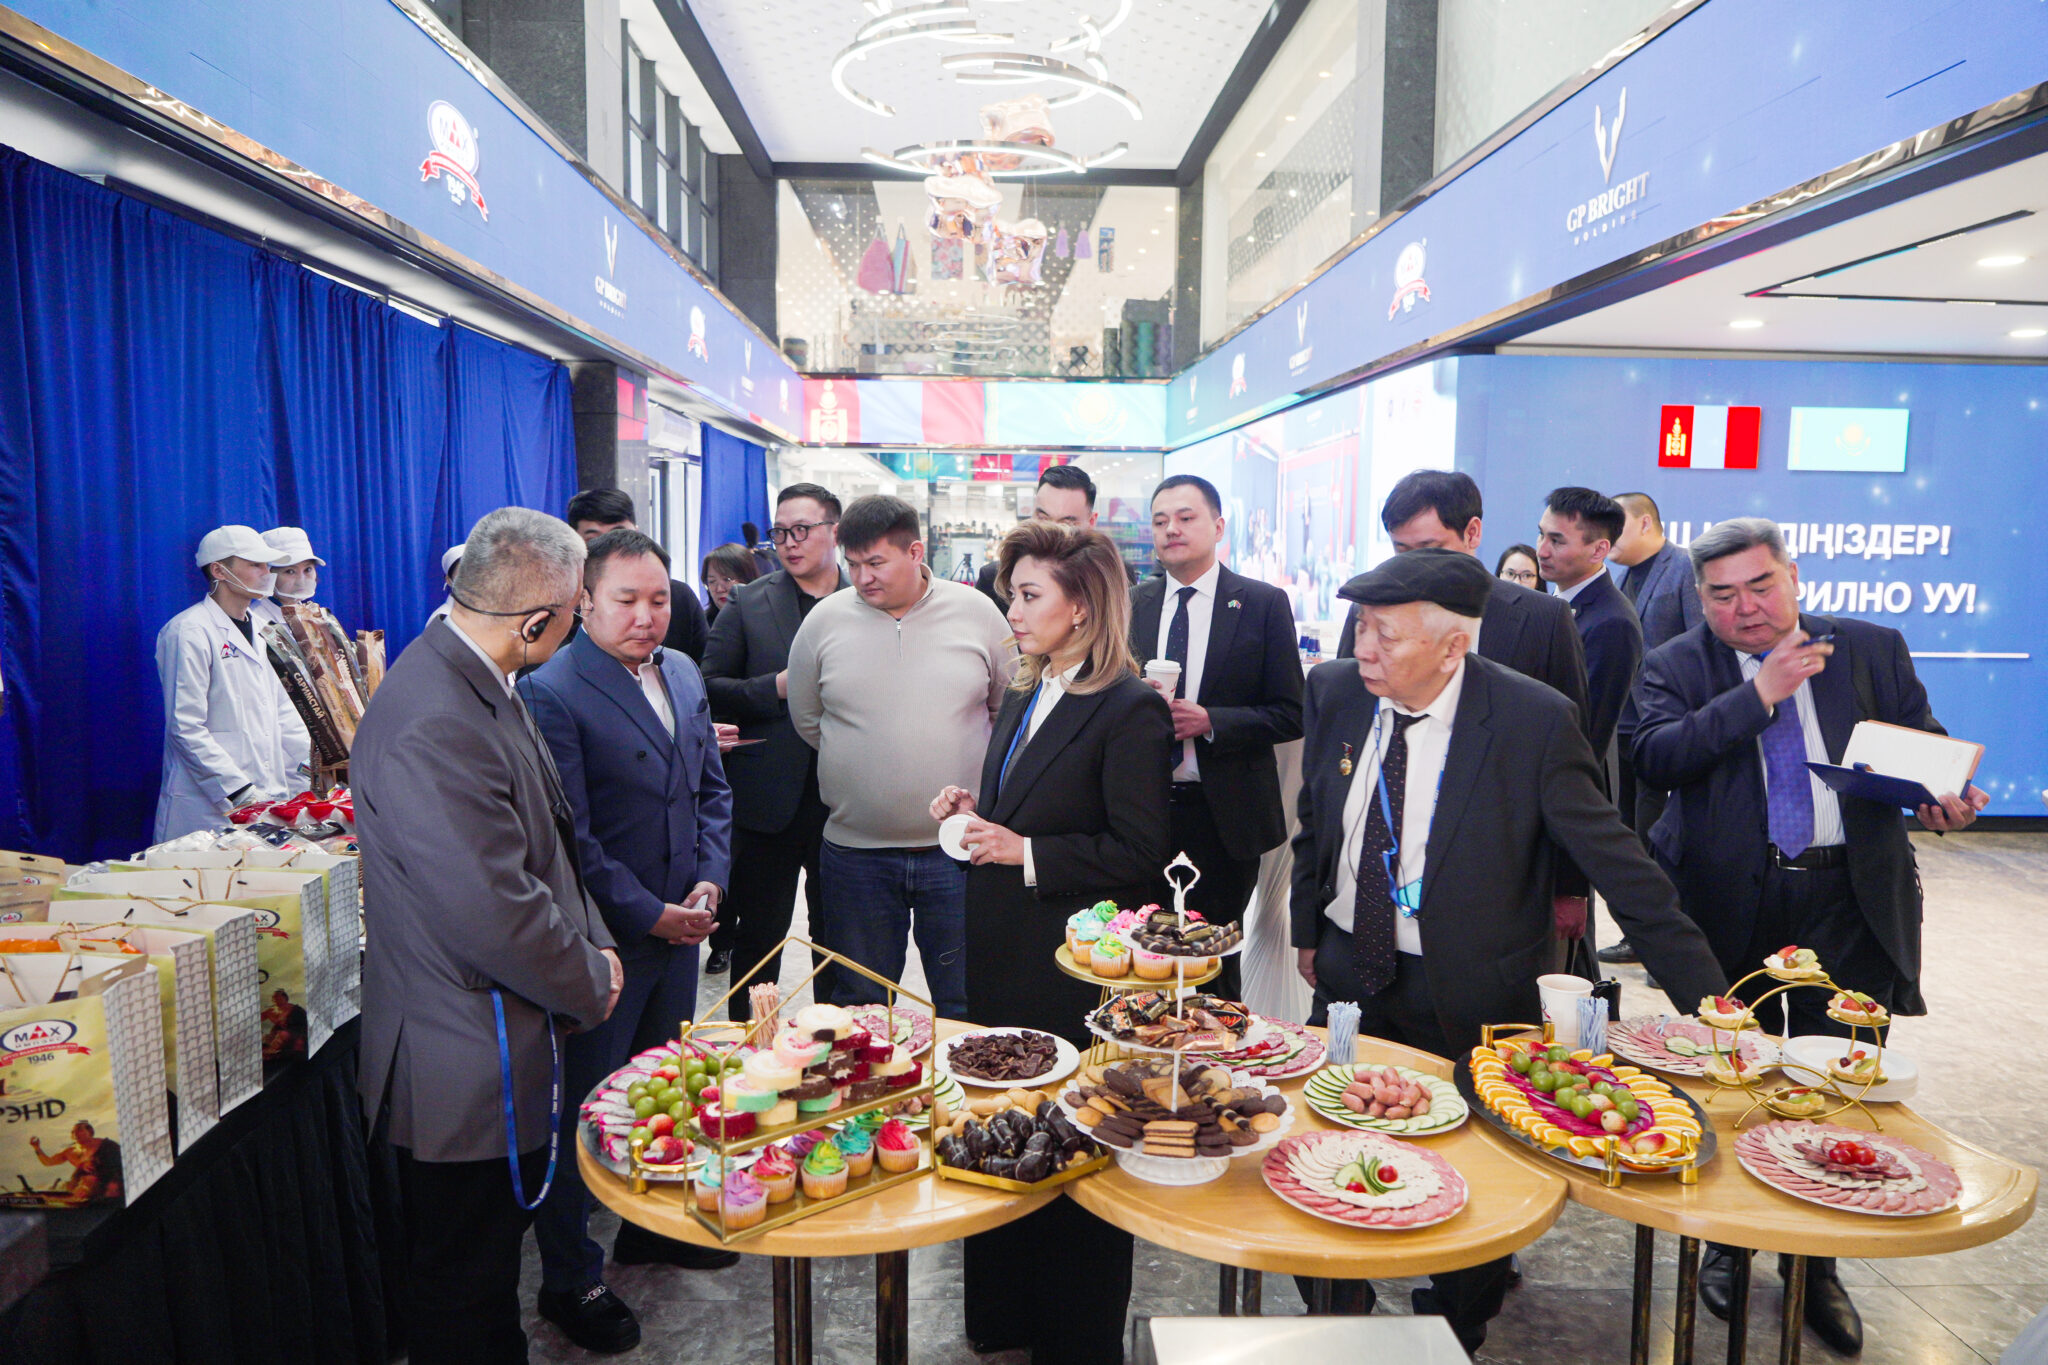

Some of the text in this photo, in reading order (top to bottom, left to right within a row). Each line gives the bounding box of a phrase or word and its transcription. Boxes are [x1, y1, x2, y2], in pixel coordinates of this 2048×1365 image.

[1566, 171, 1650, 232] GP BRIGHT
[1922, 582, 1977, 614] УУ!
[293, 671, 326, 720] САРИМСТАЙ
[14, 1025, 61, 1043] MAX
[27, 1052, 55, 1065] 1946
